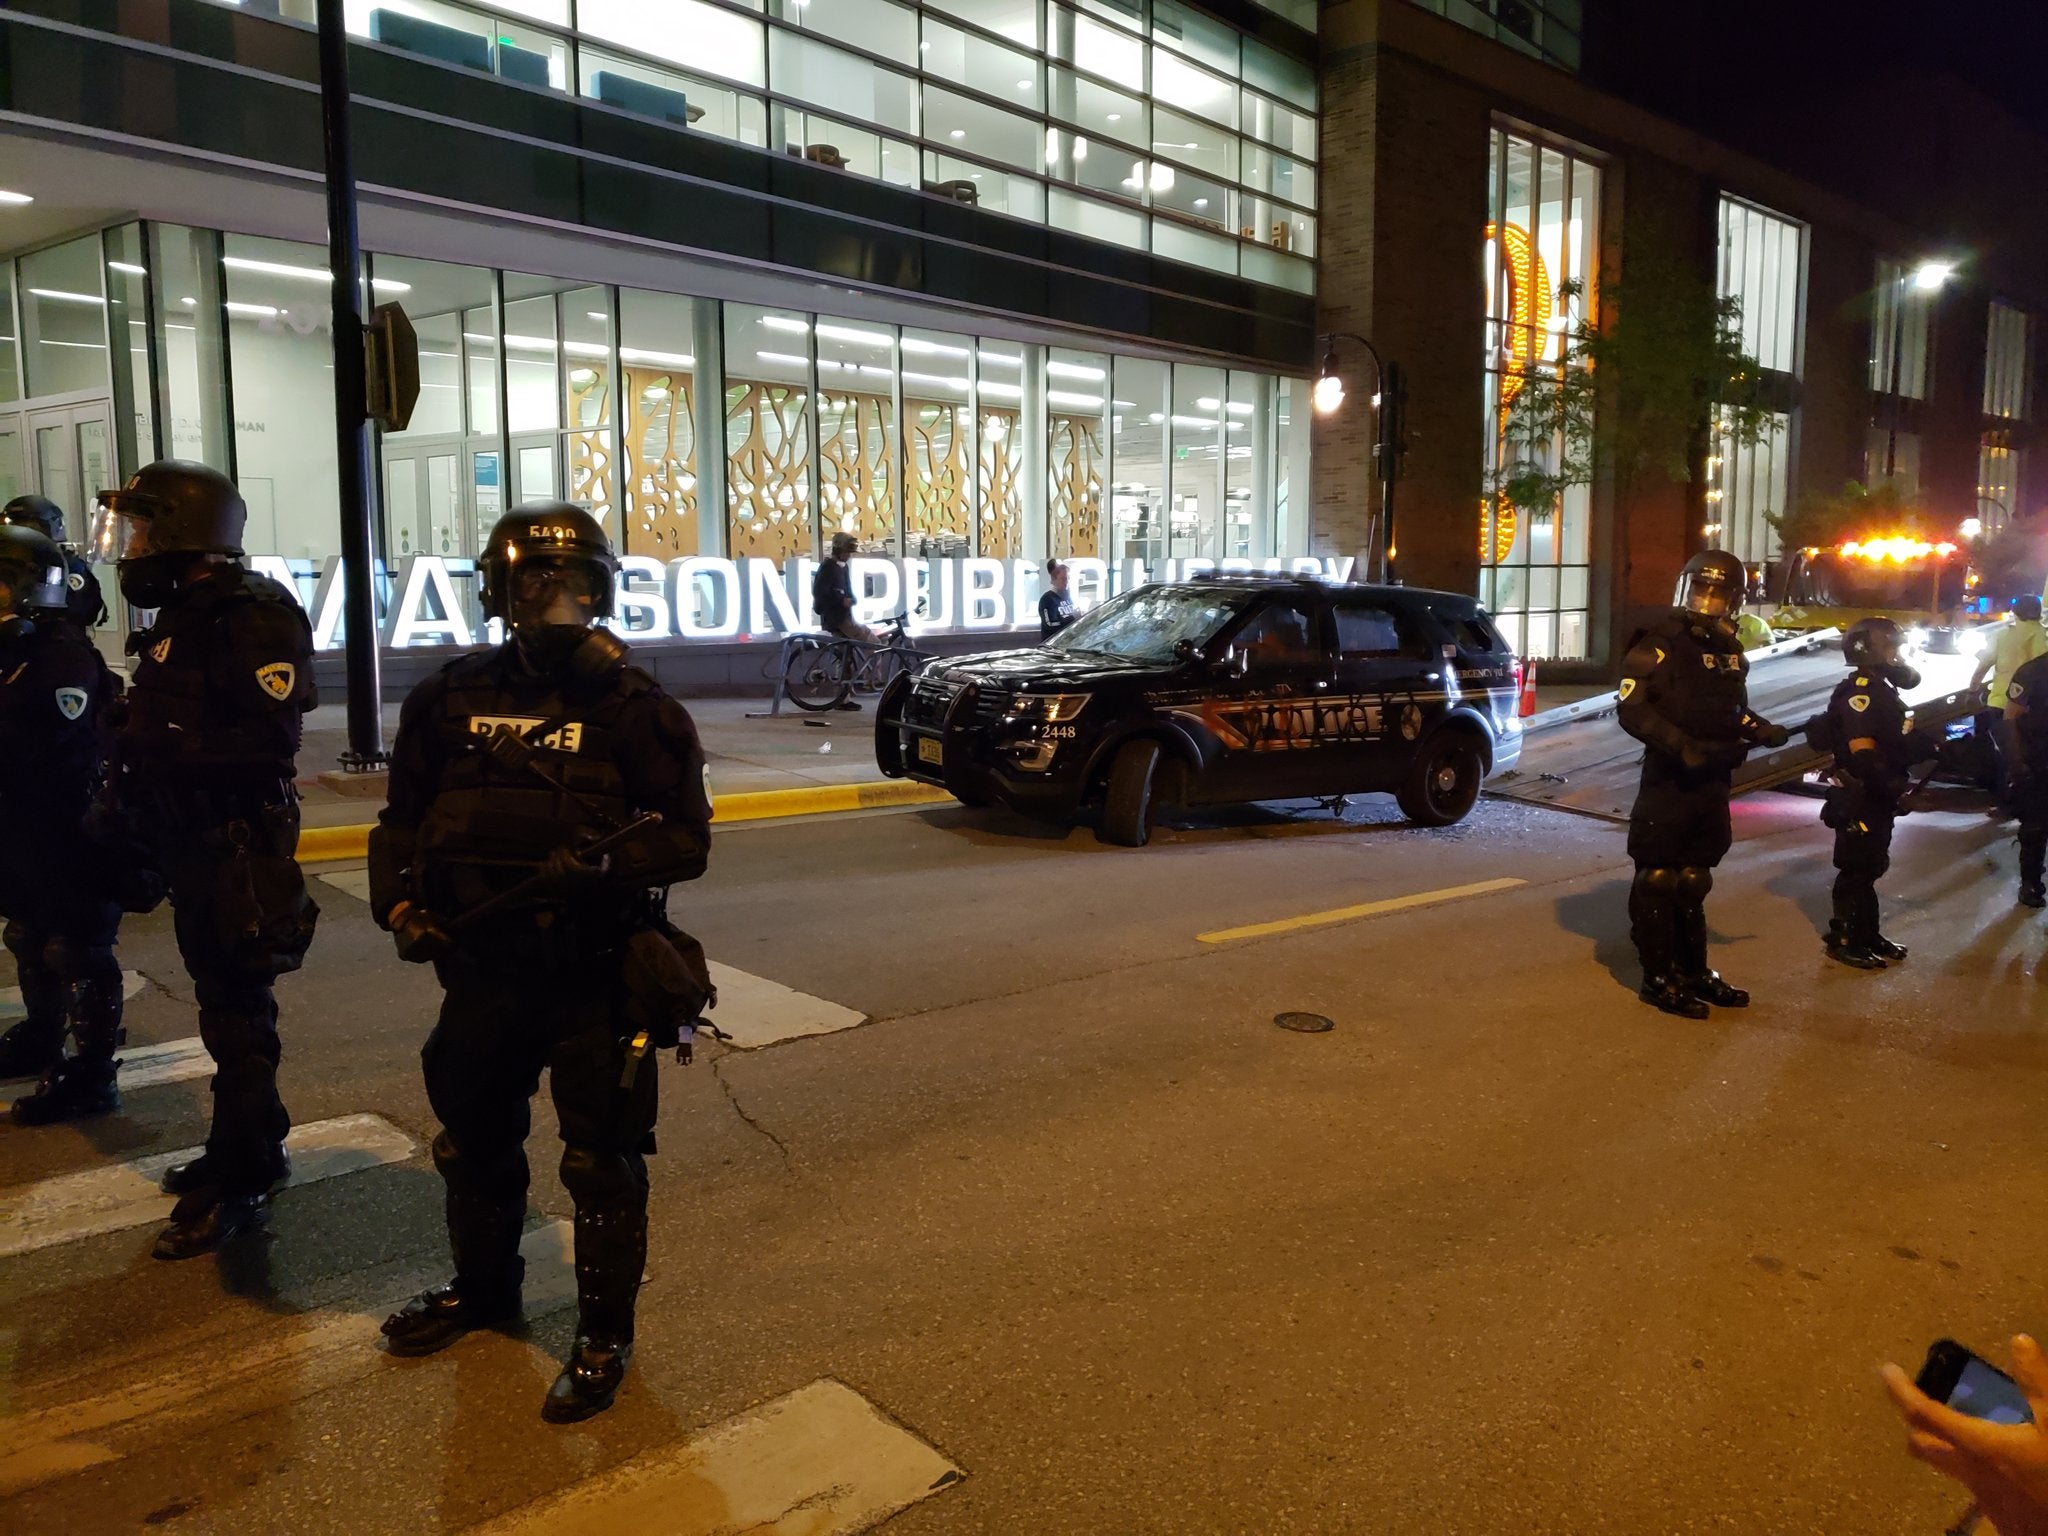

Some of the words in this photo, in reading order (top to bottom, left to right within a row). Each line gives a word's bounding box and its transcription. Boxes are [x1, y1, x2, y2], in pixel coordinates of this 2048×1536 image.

[250, 555, 823, 650] MASON
[851, 557, 1108, 633] PUBLC
[1450, 668, 1493, 679] ERGENCY
[477, 721, 577, 750] POLCE
[1041, 726, 1076, 739] 2448
